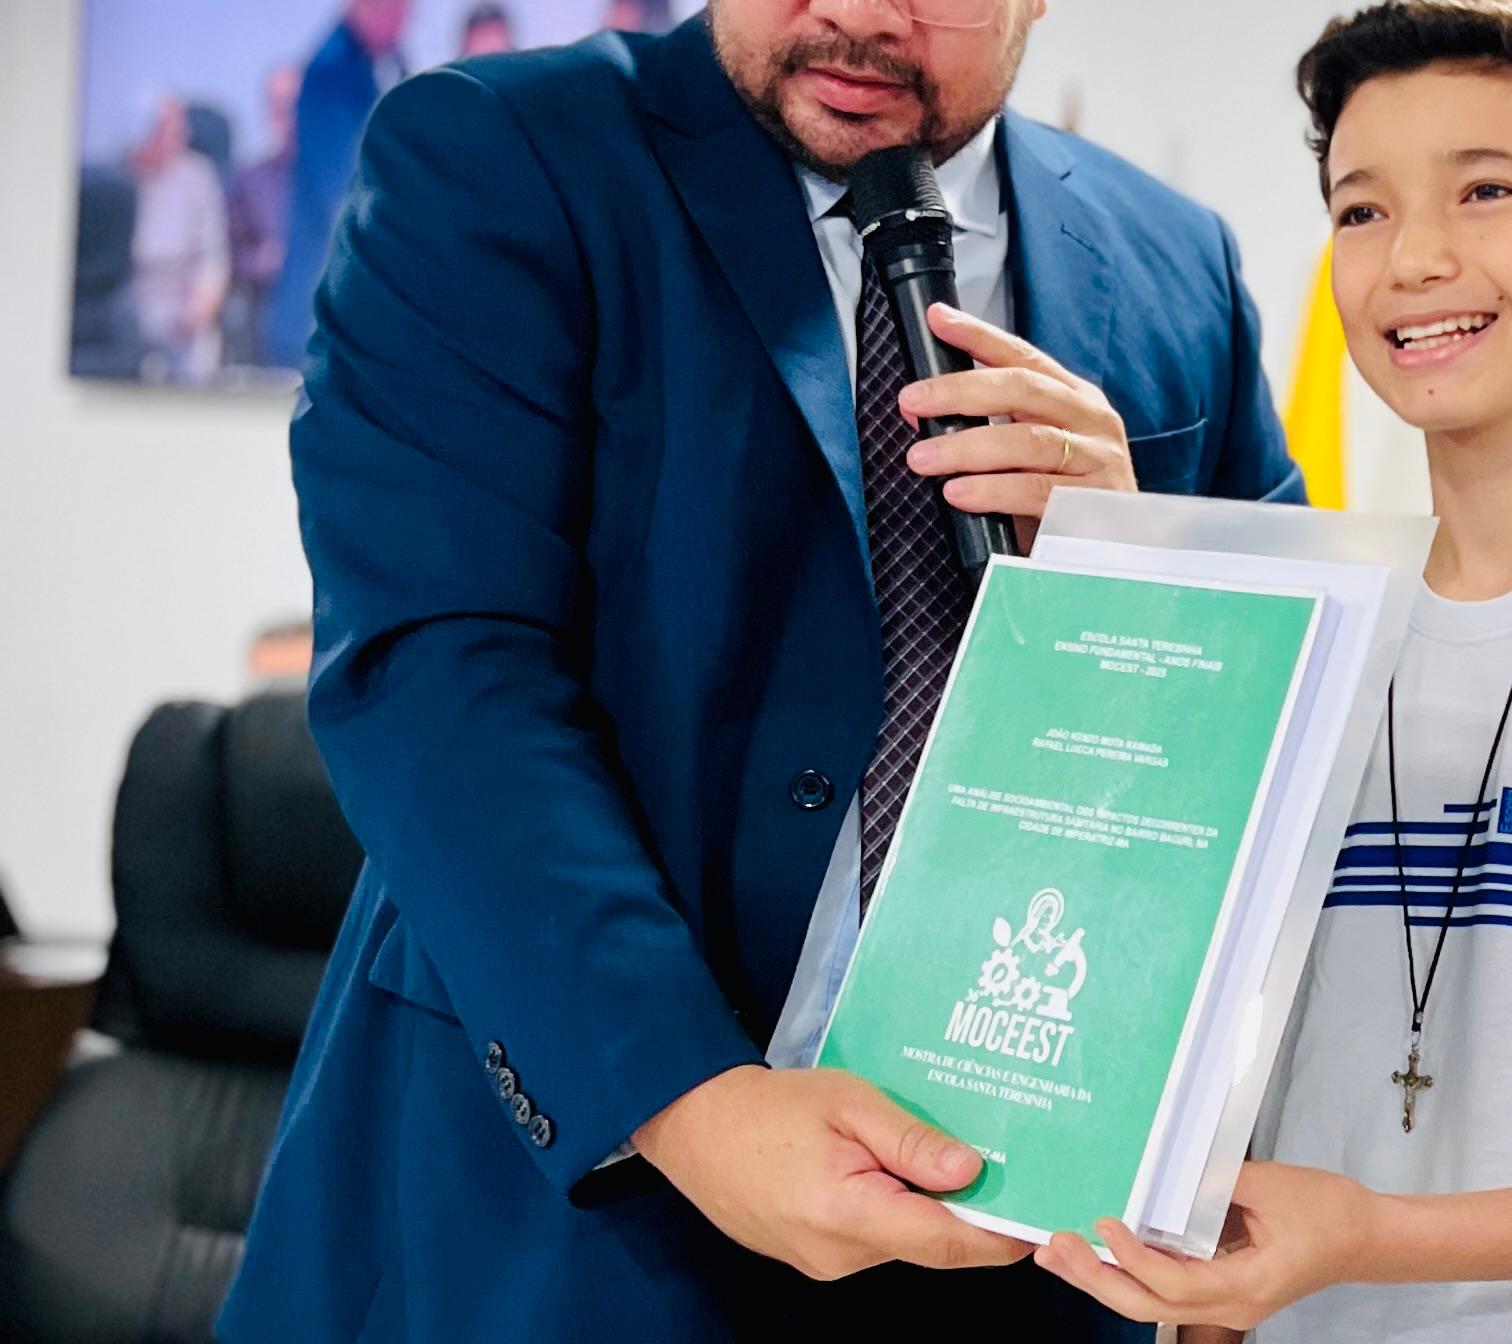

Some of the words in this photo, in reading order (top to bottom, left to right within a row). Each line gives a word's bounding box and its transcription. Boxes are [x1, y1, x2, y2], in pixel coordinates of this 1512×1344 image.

[1119, 635, 1149, 648] SANTA
[944, 1001, 1075, 1067] MOCEEST
[902, 1045, 942, 1065] MOSTRA
[943, 1056, 957, 1068] DE
[957, 1058, 1001, 1080] CIÊNCIAS
[1011, 1073, 1076, 1099] ENGENHARIA
[1076, 1086, 1092, 1103] DA
[927, 1068, 965, 1089] ESCOLA
[965, 1077, 997, 1097] SANTA
[998, 1086, 1053, 1111] TERESINHA
